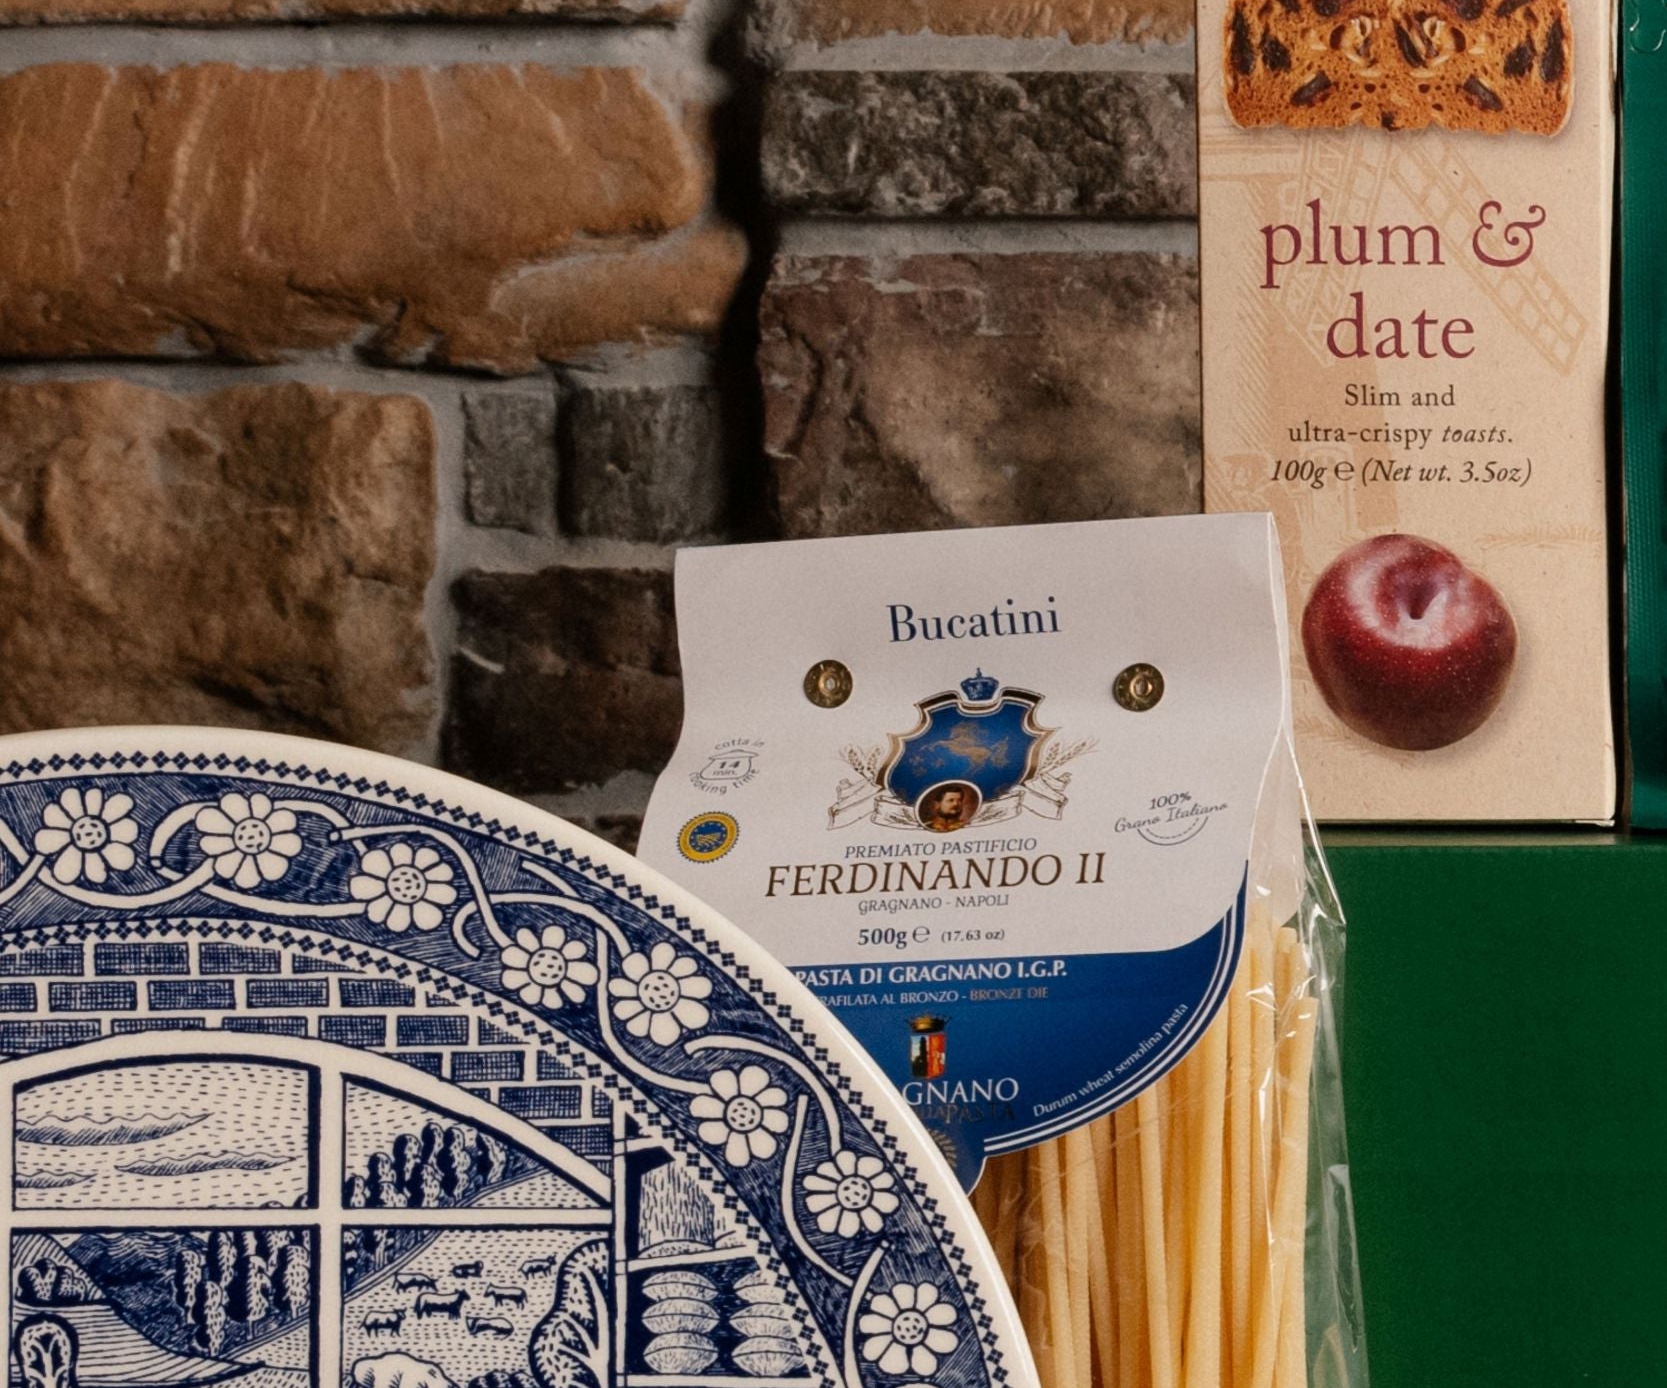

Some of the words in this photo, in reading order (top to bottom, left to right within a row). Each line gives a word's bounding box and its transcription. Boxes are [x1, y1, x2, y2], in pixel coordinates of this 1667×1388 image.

[1259, 198, 1445, 289] plum
[1473, 200, 1546, 267] &
[1326, 291, 1476, 359] date
[1344, 384, 1401, 408] Slim
[1411, 384, 1456, 408] and
[1288, 422, 1433, 449] ultra-crispy
[1442, 424, 1514, 445] toasts.
[1268, 459, 1327, 489] 100g
[1361, 459, 1413, 488] (Net
[1417, 462, 1452, 484] wt.
[1458, 458, 1533, 488] 3.5oz)
[886, 594, 1063, 643] Bucatini
[844, 842, 936, 859] PREMIATO
[940, 837, 1038, 856] PASTIFICIO
[764, 853, 1063, 897] FERDINANDO
[1075, 852, 1107, 884] II
[857, 896, 942, 914] GRAGNANO
[954, 893, 1010, 908] NAPOLI
[796, 965, 857, 987] PASTA
[859, 966, 884, 985] DI
[888, 962, 1012, 984] GRAGNANO
[1016, 960, 1068, 980] I.G.P.
